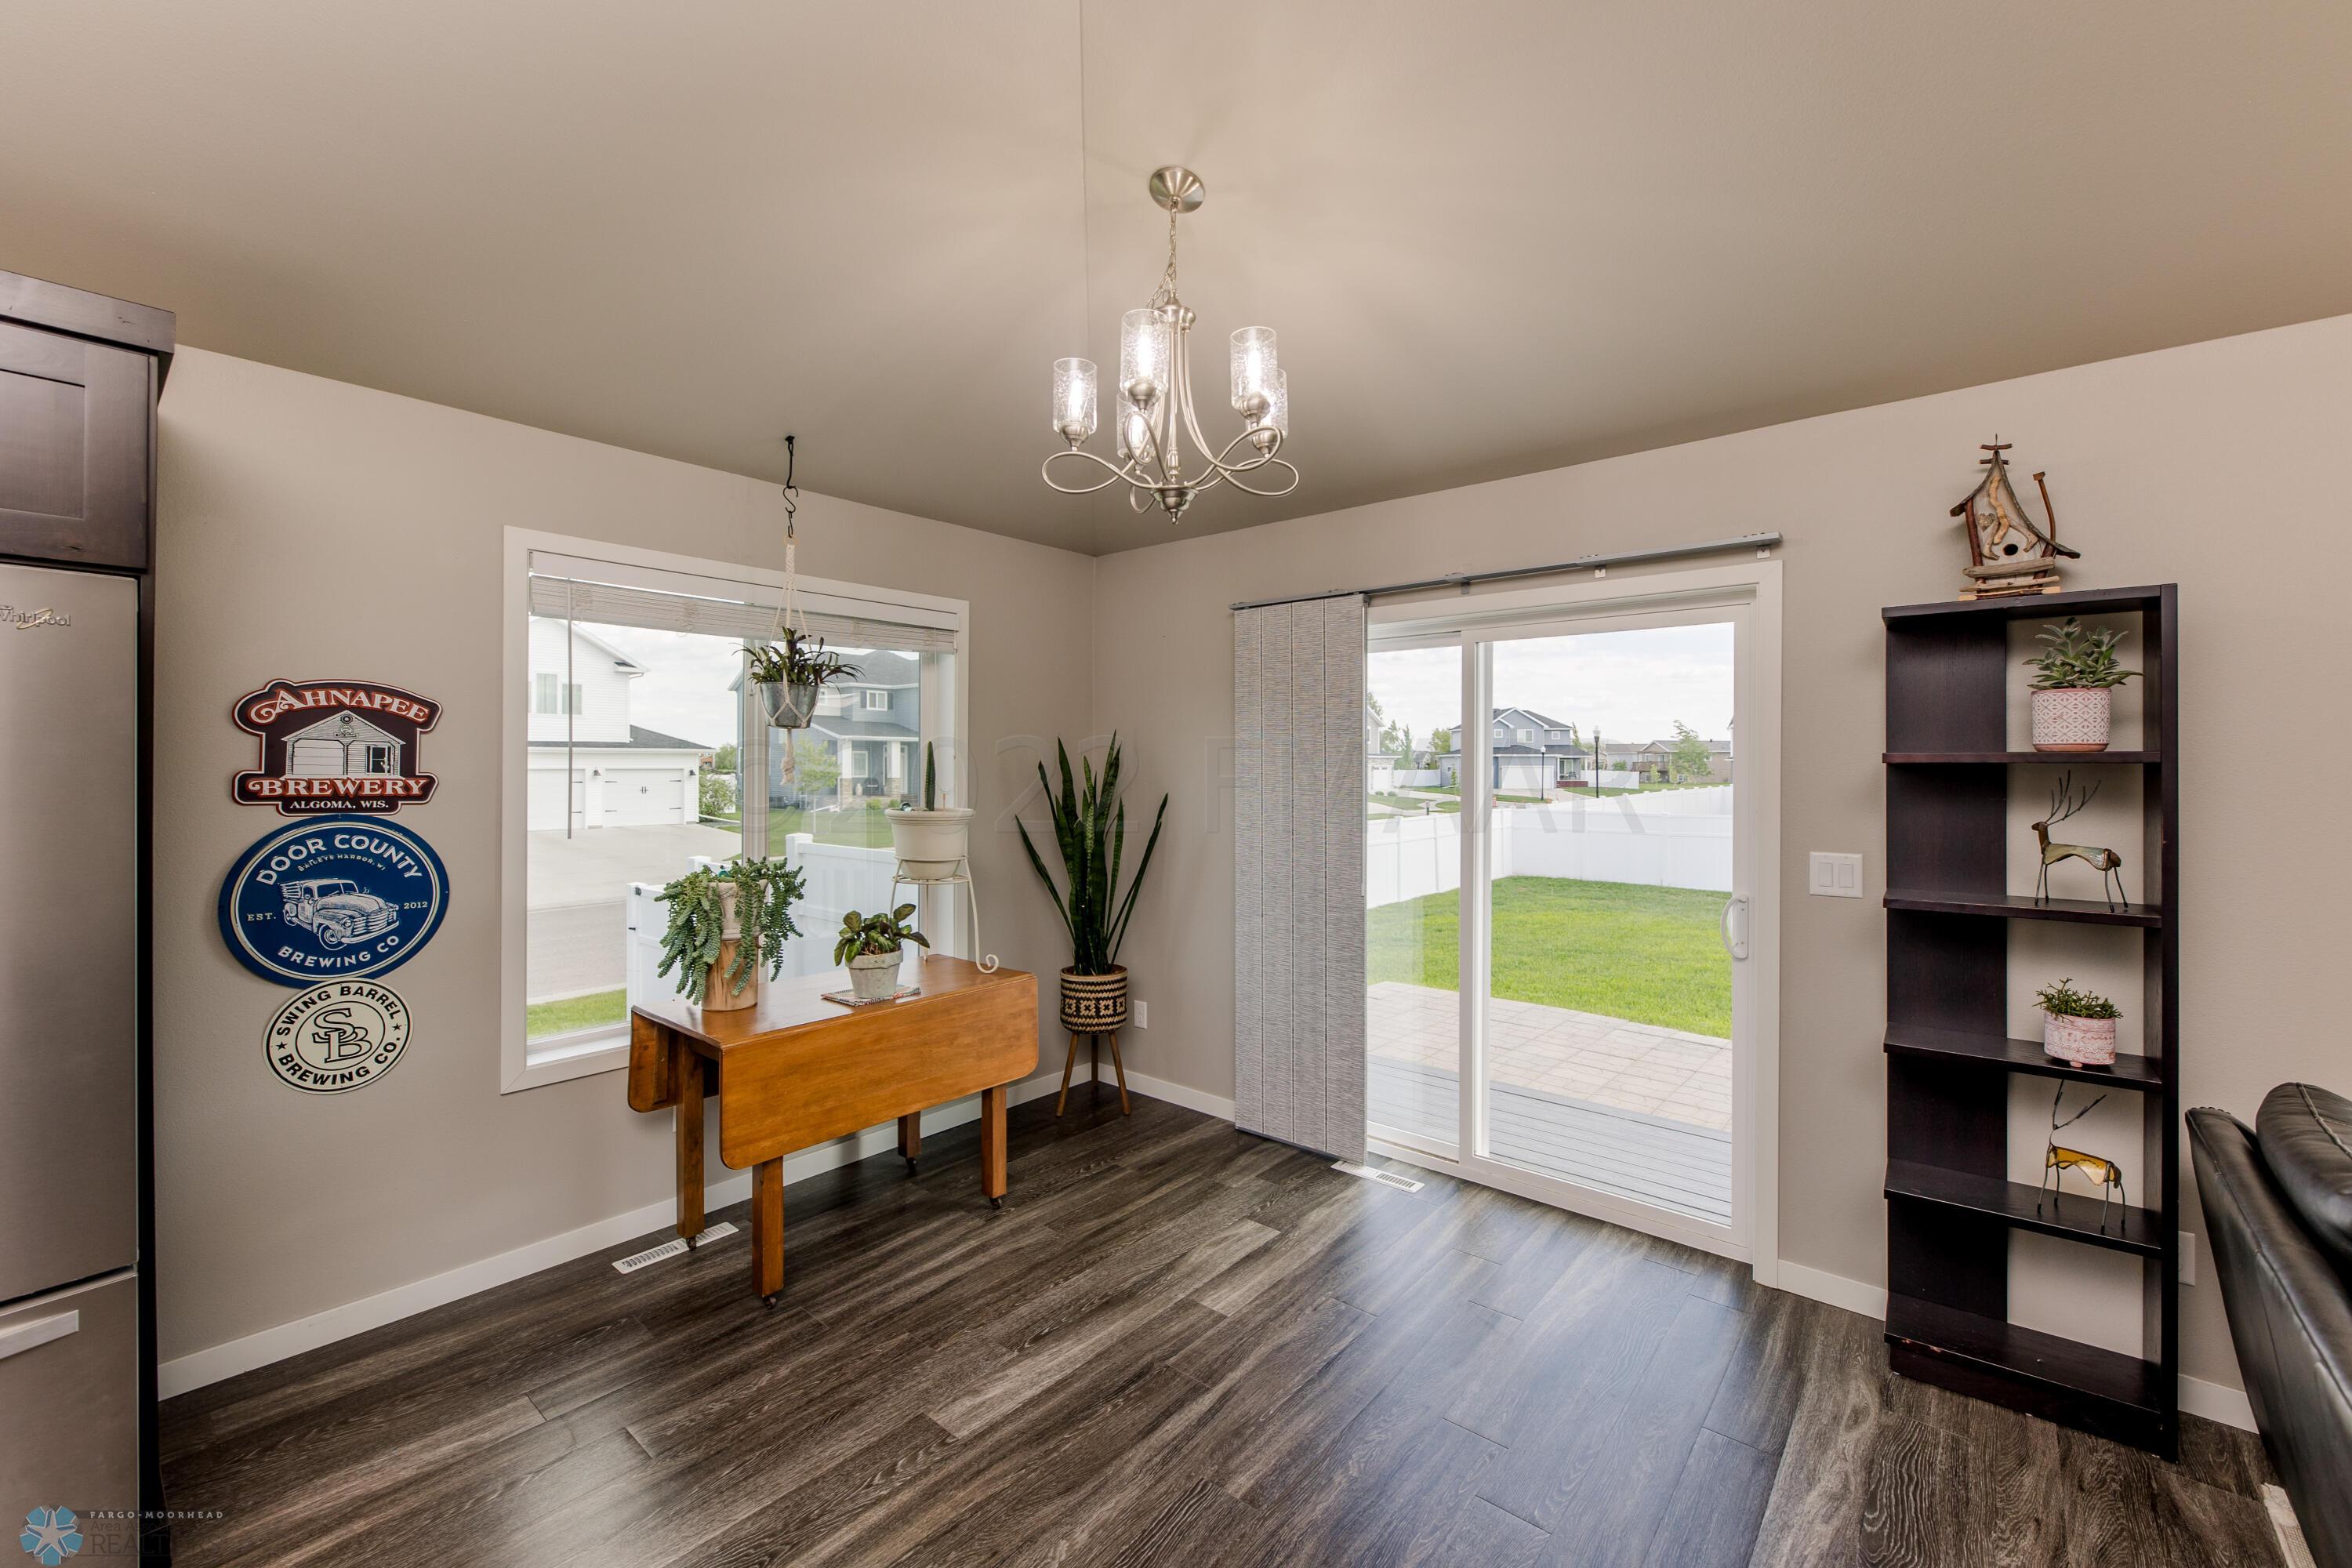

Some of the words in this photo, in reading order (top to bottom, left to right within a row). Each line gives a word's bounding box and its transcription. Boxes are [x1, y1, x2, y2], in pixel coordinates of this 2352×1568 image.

[250, 688, 430, 724] AHNAPEE
[248, 779, 428, 797] BREWERY
[289, 800, 356, 809] ALGOMA,
[361, 800, 389, 808] WIS.
[256, 837, 326, 886] DOOR
[334, 834, 423, 879] COUNTY
[246, 913, 276, 921] EST.
[403, 902, 428, 910] 2012
[277, 946, 372, 968] BREWING
[376, 935, 400, 953] CO
[276, 989, 332, 1036] SWING
[339, 985, 401, 1020] BARREL
[278, 1053, 371, 1085] BREWING
